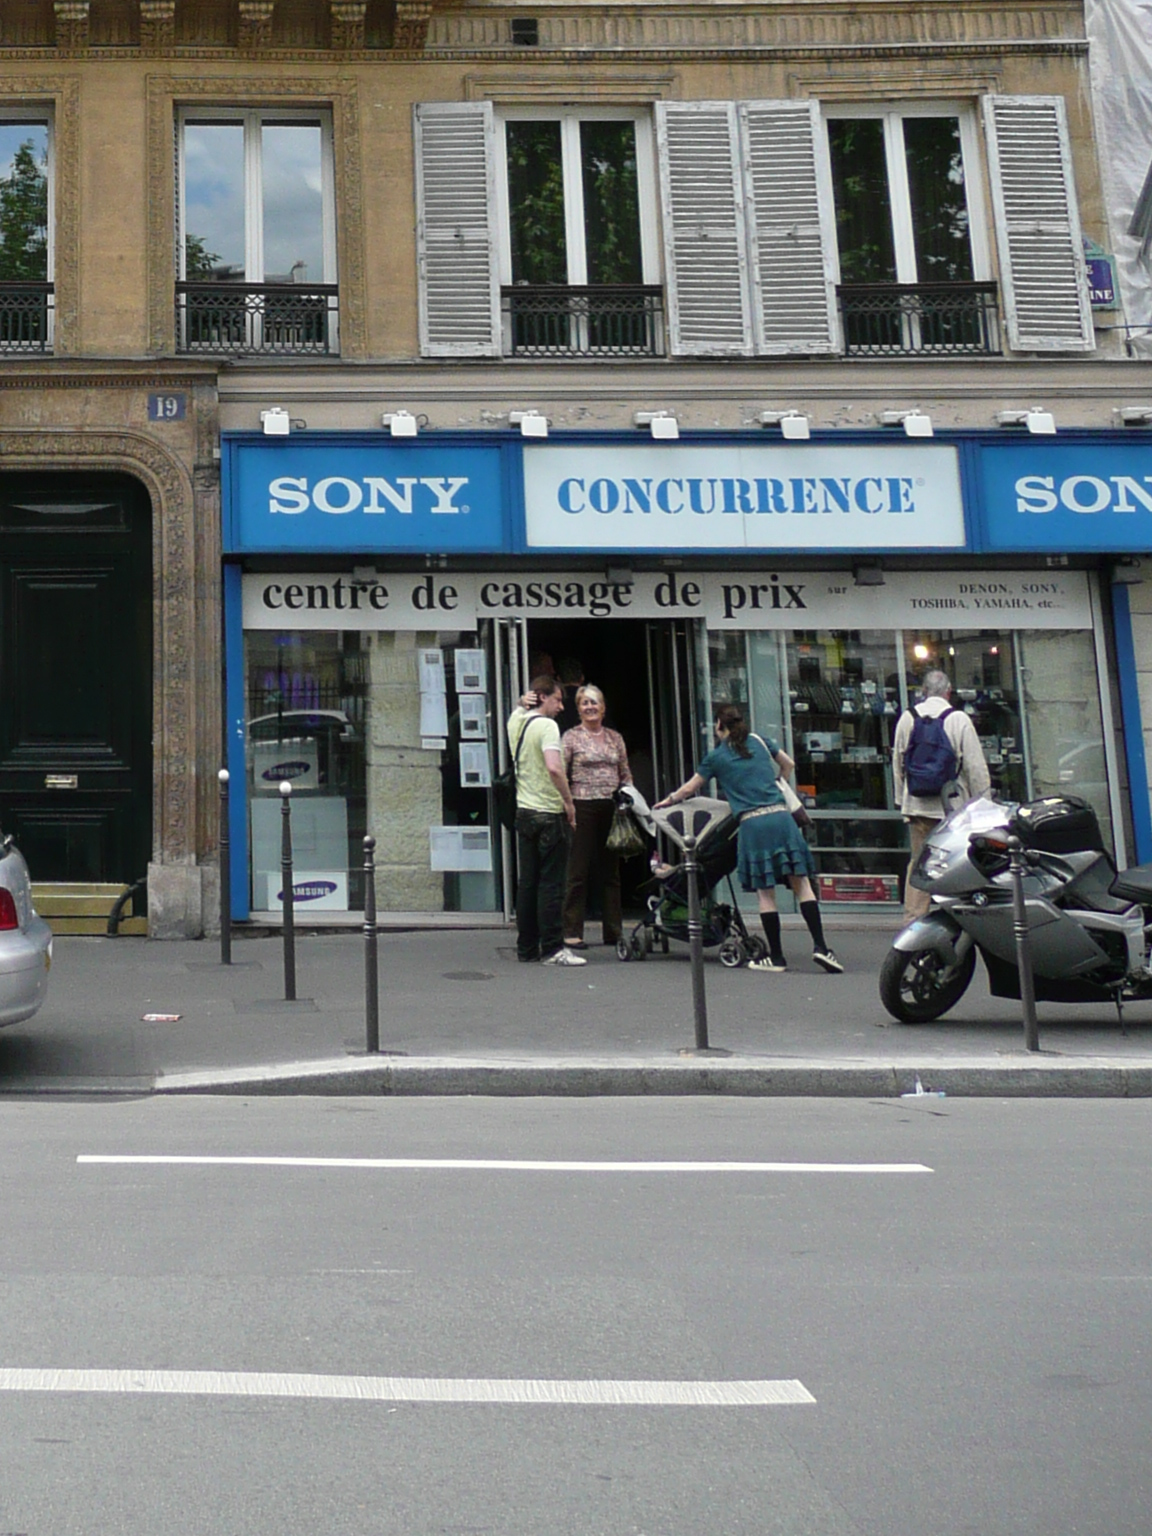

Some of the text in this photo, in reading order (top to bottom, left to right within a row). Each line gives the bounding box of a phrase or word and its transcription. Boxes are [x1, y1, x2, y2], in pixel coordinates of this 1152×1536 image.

[156, 396, 178, 417] 19
[268, 476, 470, 514] SONY
[557, 477, 915, 515] CONCURRENCE
[262, 572, 848, 619] centre de cassage de prix sur
[291, 885, 331, 897] AMSUNG
